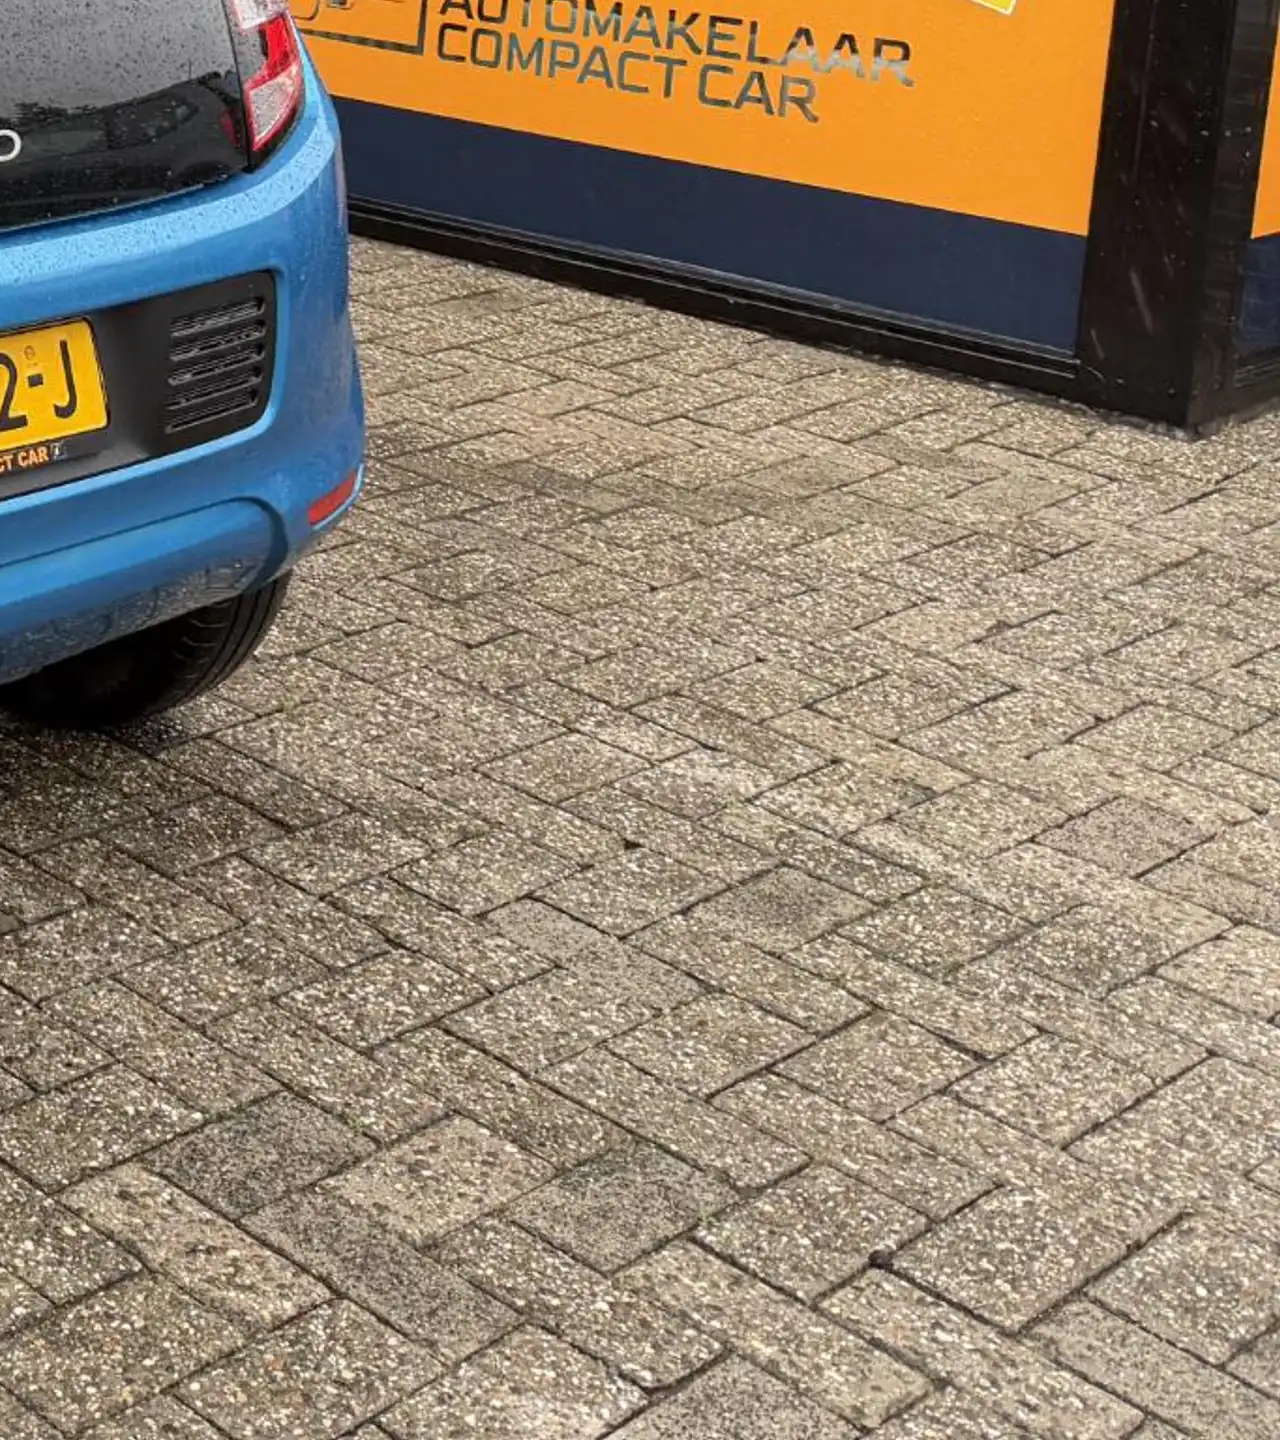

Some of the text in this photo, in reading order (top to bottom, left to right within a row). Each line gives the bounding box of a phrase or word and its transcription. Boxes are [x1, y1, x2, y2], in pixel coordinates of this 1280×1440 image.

[437, 22, 820, 123] COMPACT CAR
[16, 445, 51, 469] CAR
